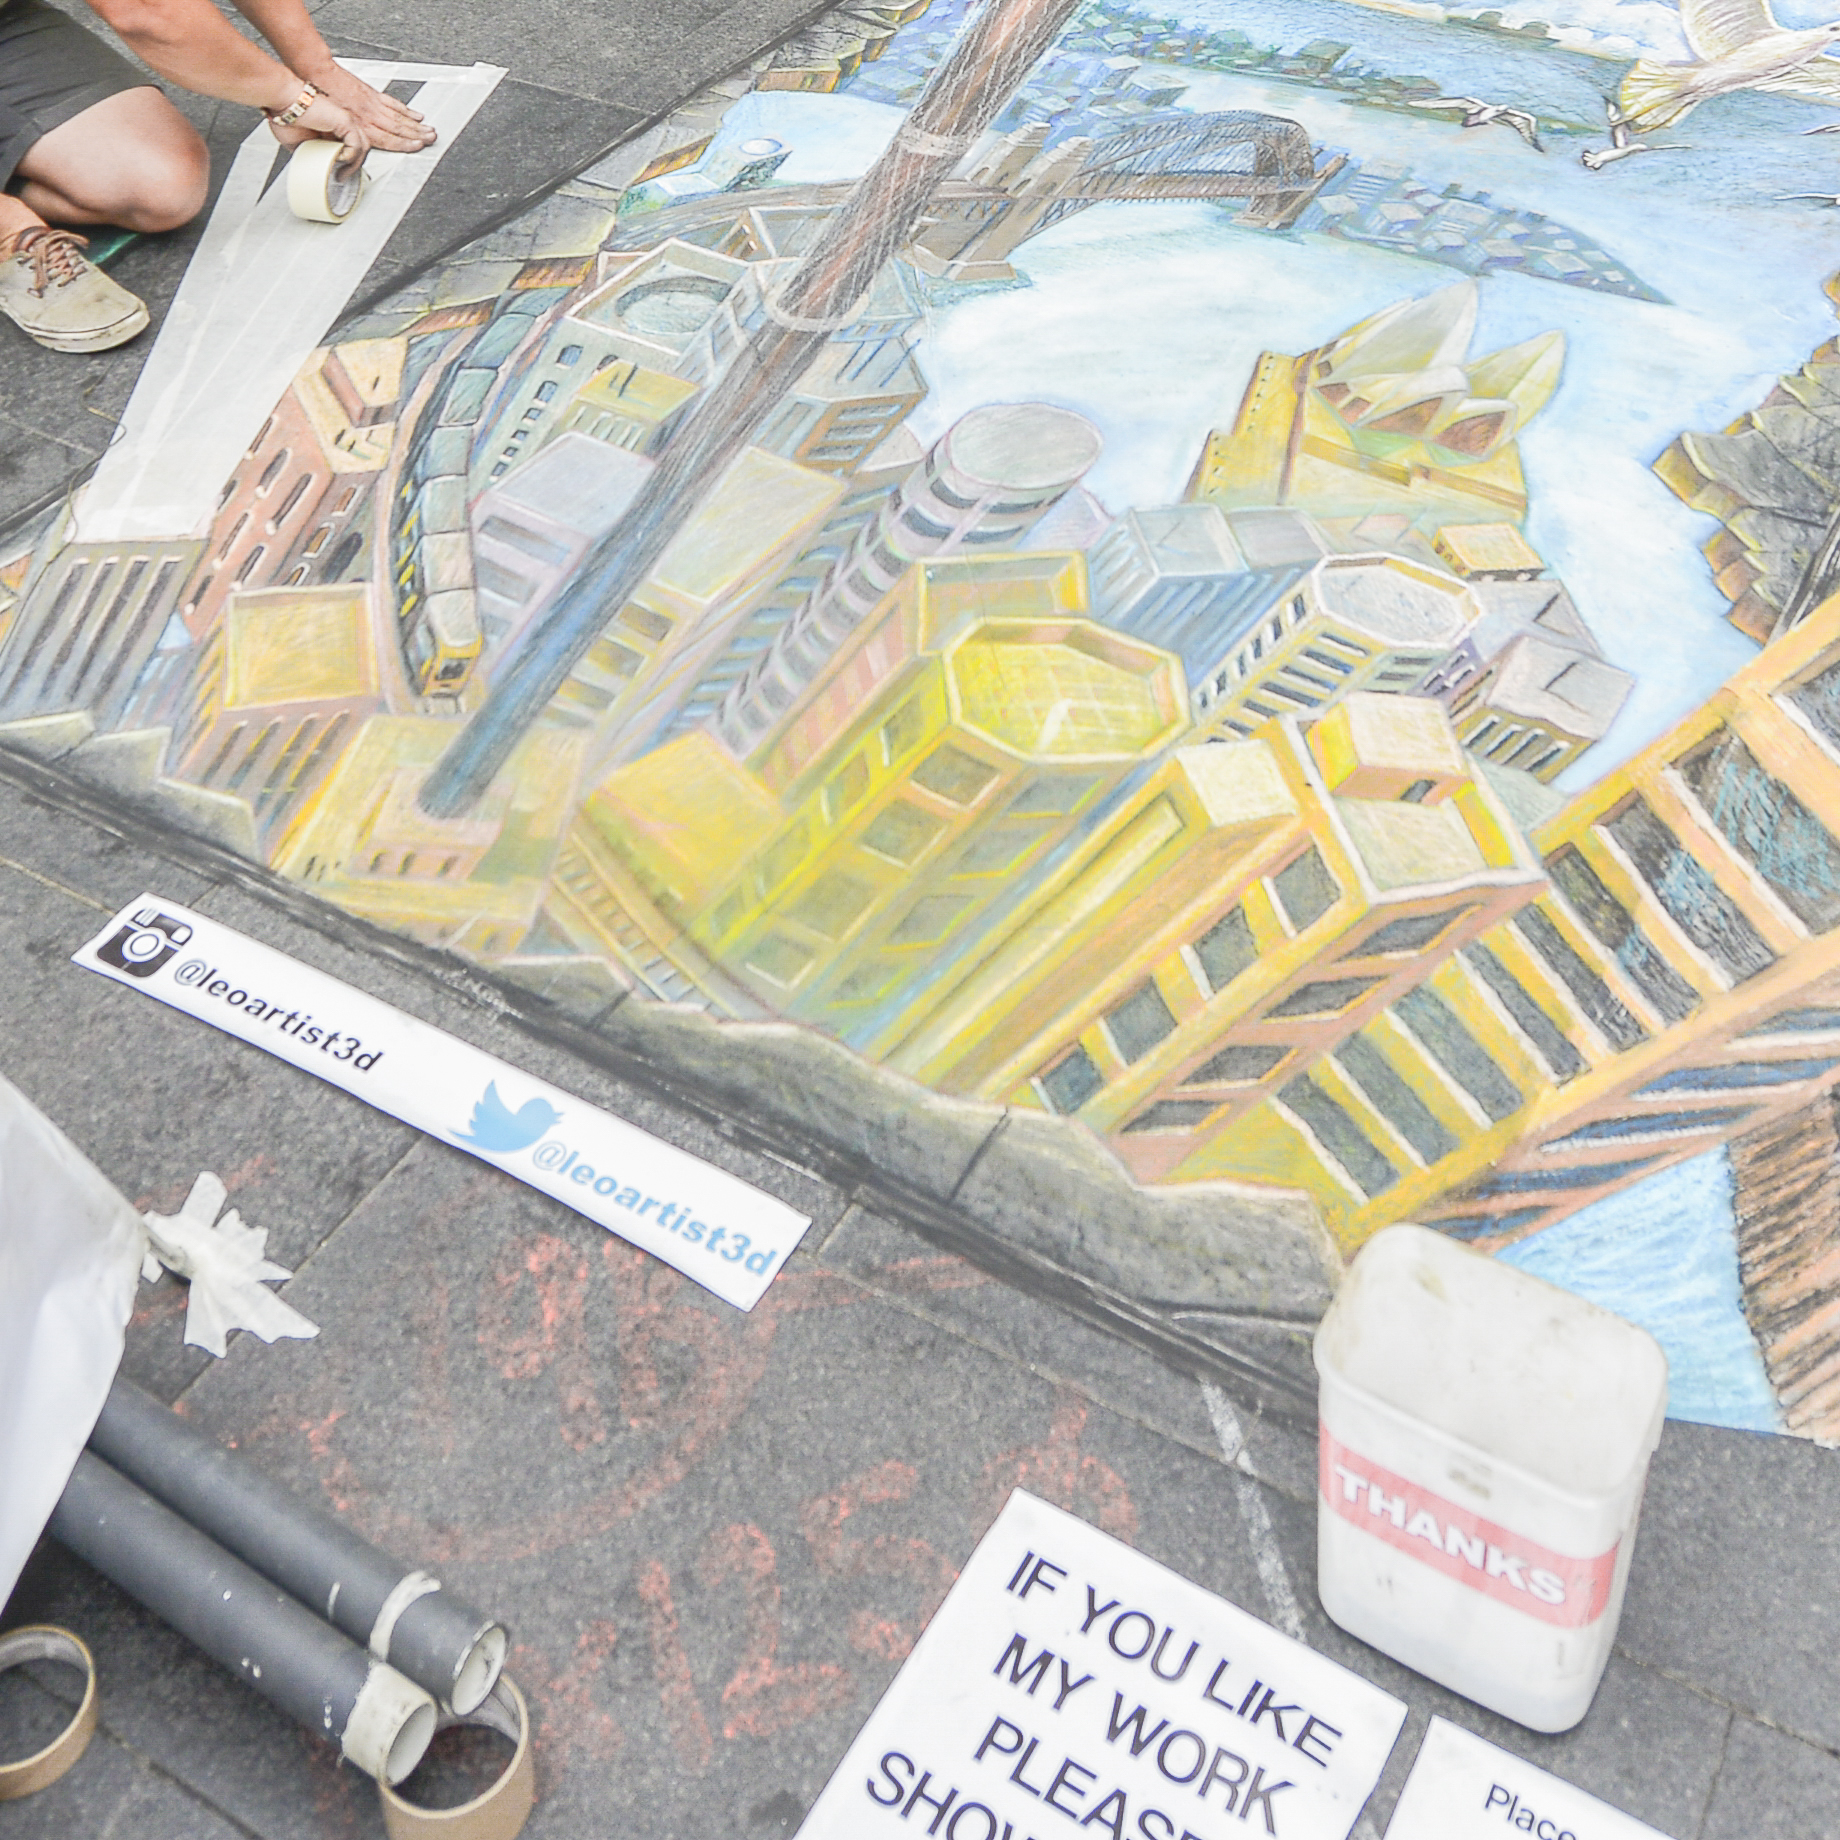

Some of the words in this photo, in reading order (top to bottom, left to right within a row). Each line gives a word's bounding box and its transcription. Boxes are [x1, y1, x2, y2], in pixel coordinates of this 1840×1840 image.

[173, 957, 384, 1075] @leoartist3d
[530, 1140, 779, 1279] @leoartist3d
[1334, 1463, 1568, 1608] THANKS
[1004, 1550, 1069, 1601] IF
[1075, 1582, 1202, 1685] YOU
[1199, 1657, 1345, 1770] LIKE
[866, 1750, 1032, 1840] SHO
[973, 1715, 1200, 1840] PLEAS
[991, 1632, 1095, 1711] MY
[1106, 1689, 1298, 1838] WORK
